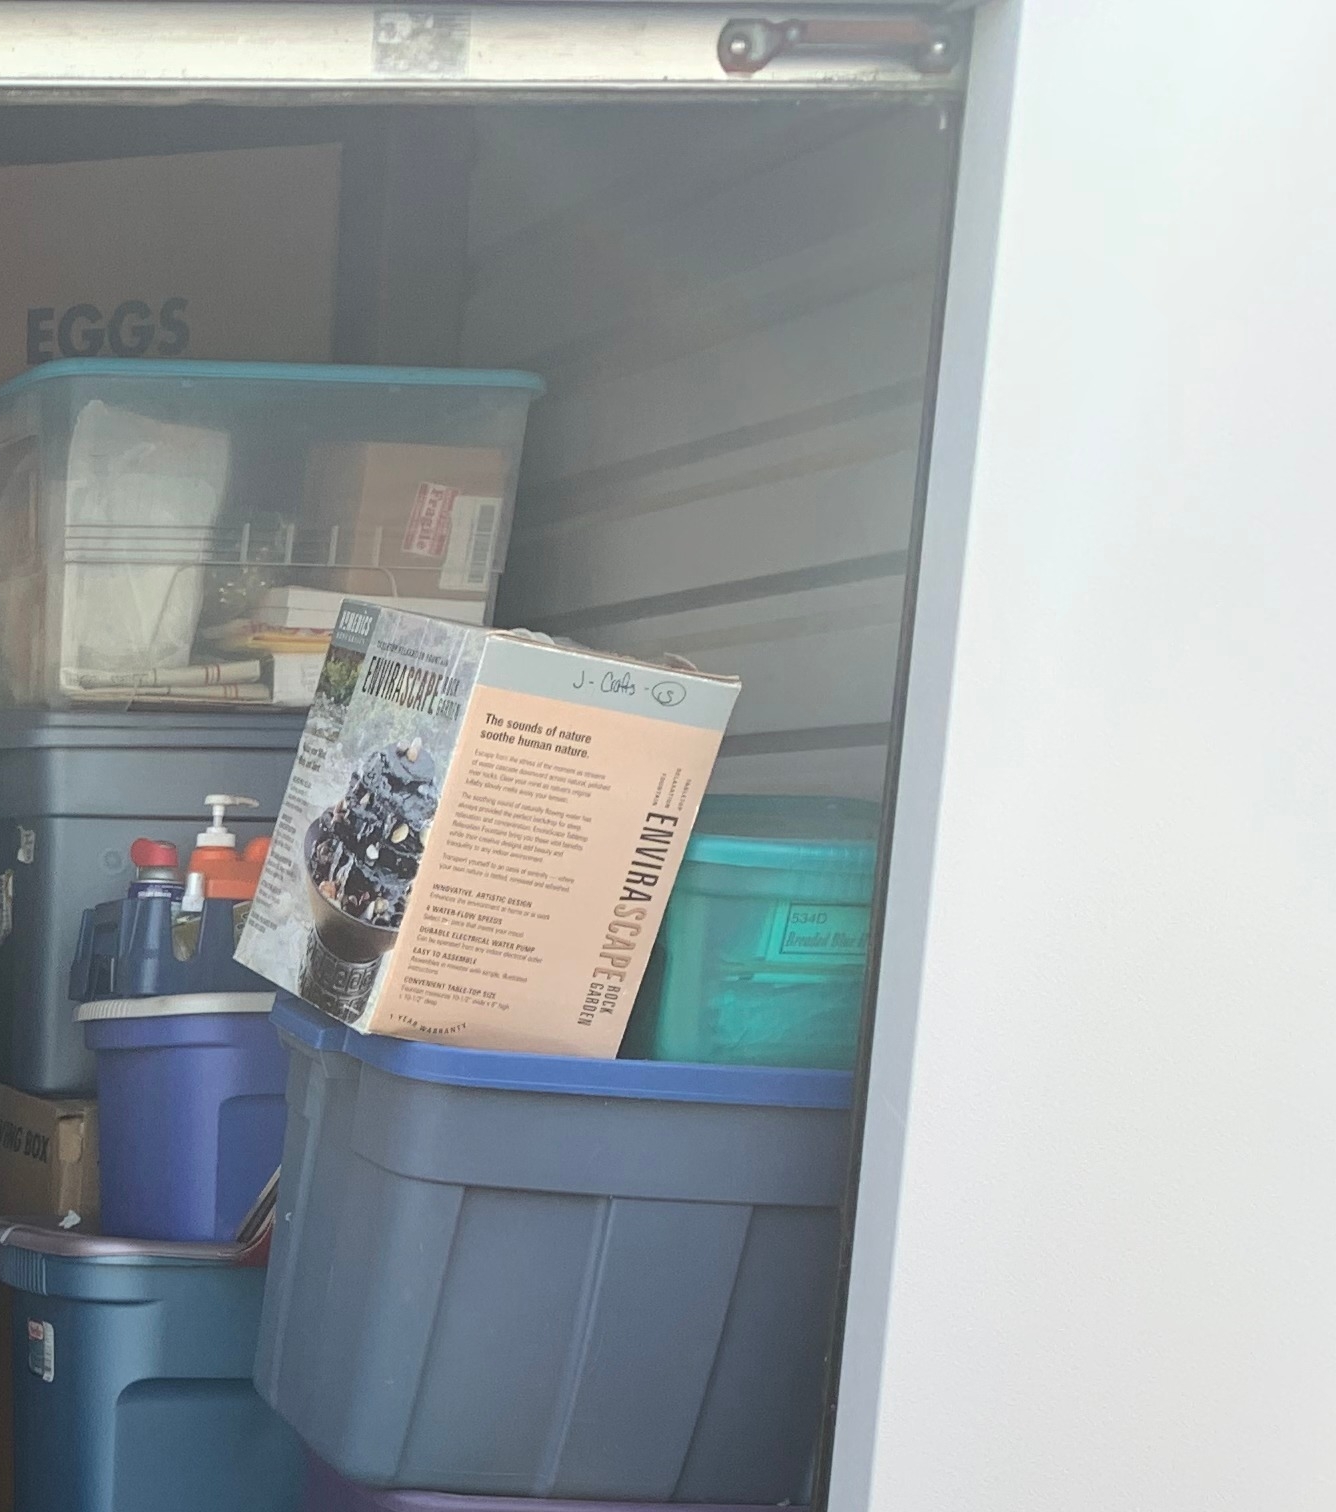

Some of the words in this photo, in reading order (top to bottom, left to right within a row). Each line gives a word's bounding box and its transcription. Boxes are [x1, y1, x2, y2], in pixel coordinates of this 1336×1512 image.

[27, 297, 190, 366] EGGS
[362, 655, 443, 716] ENVIRASCAPE
[480, 728, 515, 744] soothe
[517, 736, 552, 752] human
[554, 743, 590, 759] nature.
[485, 712, 504, 728] The
[506, 717, 543, 736] sounds
[545, 725, 557, 738] of
[558, 730, 592, 744] nature
[592, 811, 679, 983] ENVIRASCAPE
[790, 911, 827, 926] 534D
[419, 925, 450, 939] DURABLE
[451, 931, 490, 947] ELECTRICAL
[491, 939, 514, 950] WATER
[577, 983, 604, 1027] GARDEN
[599, 984, 622, 1016] ROCK
[419, 1021, 467, 1035] WARRANTY
